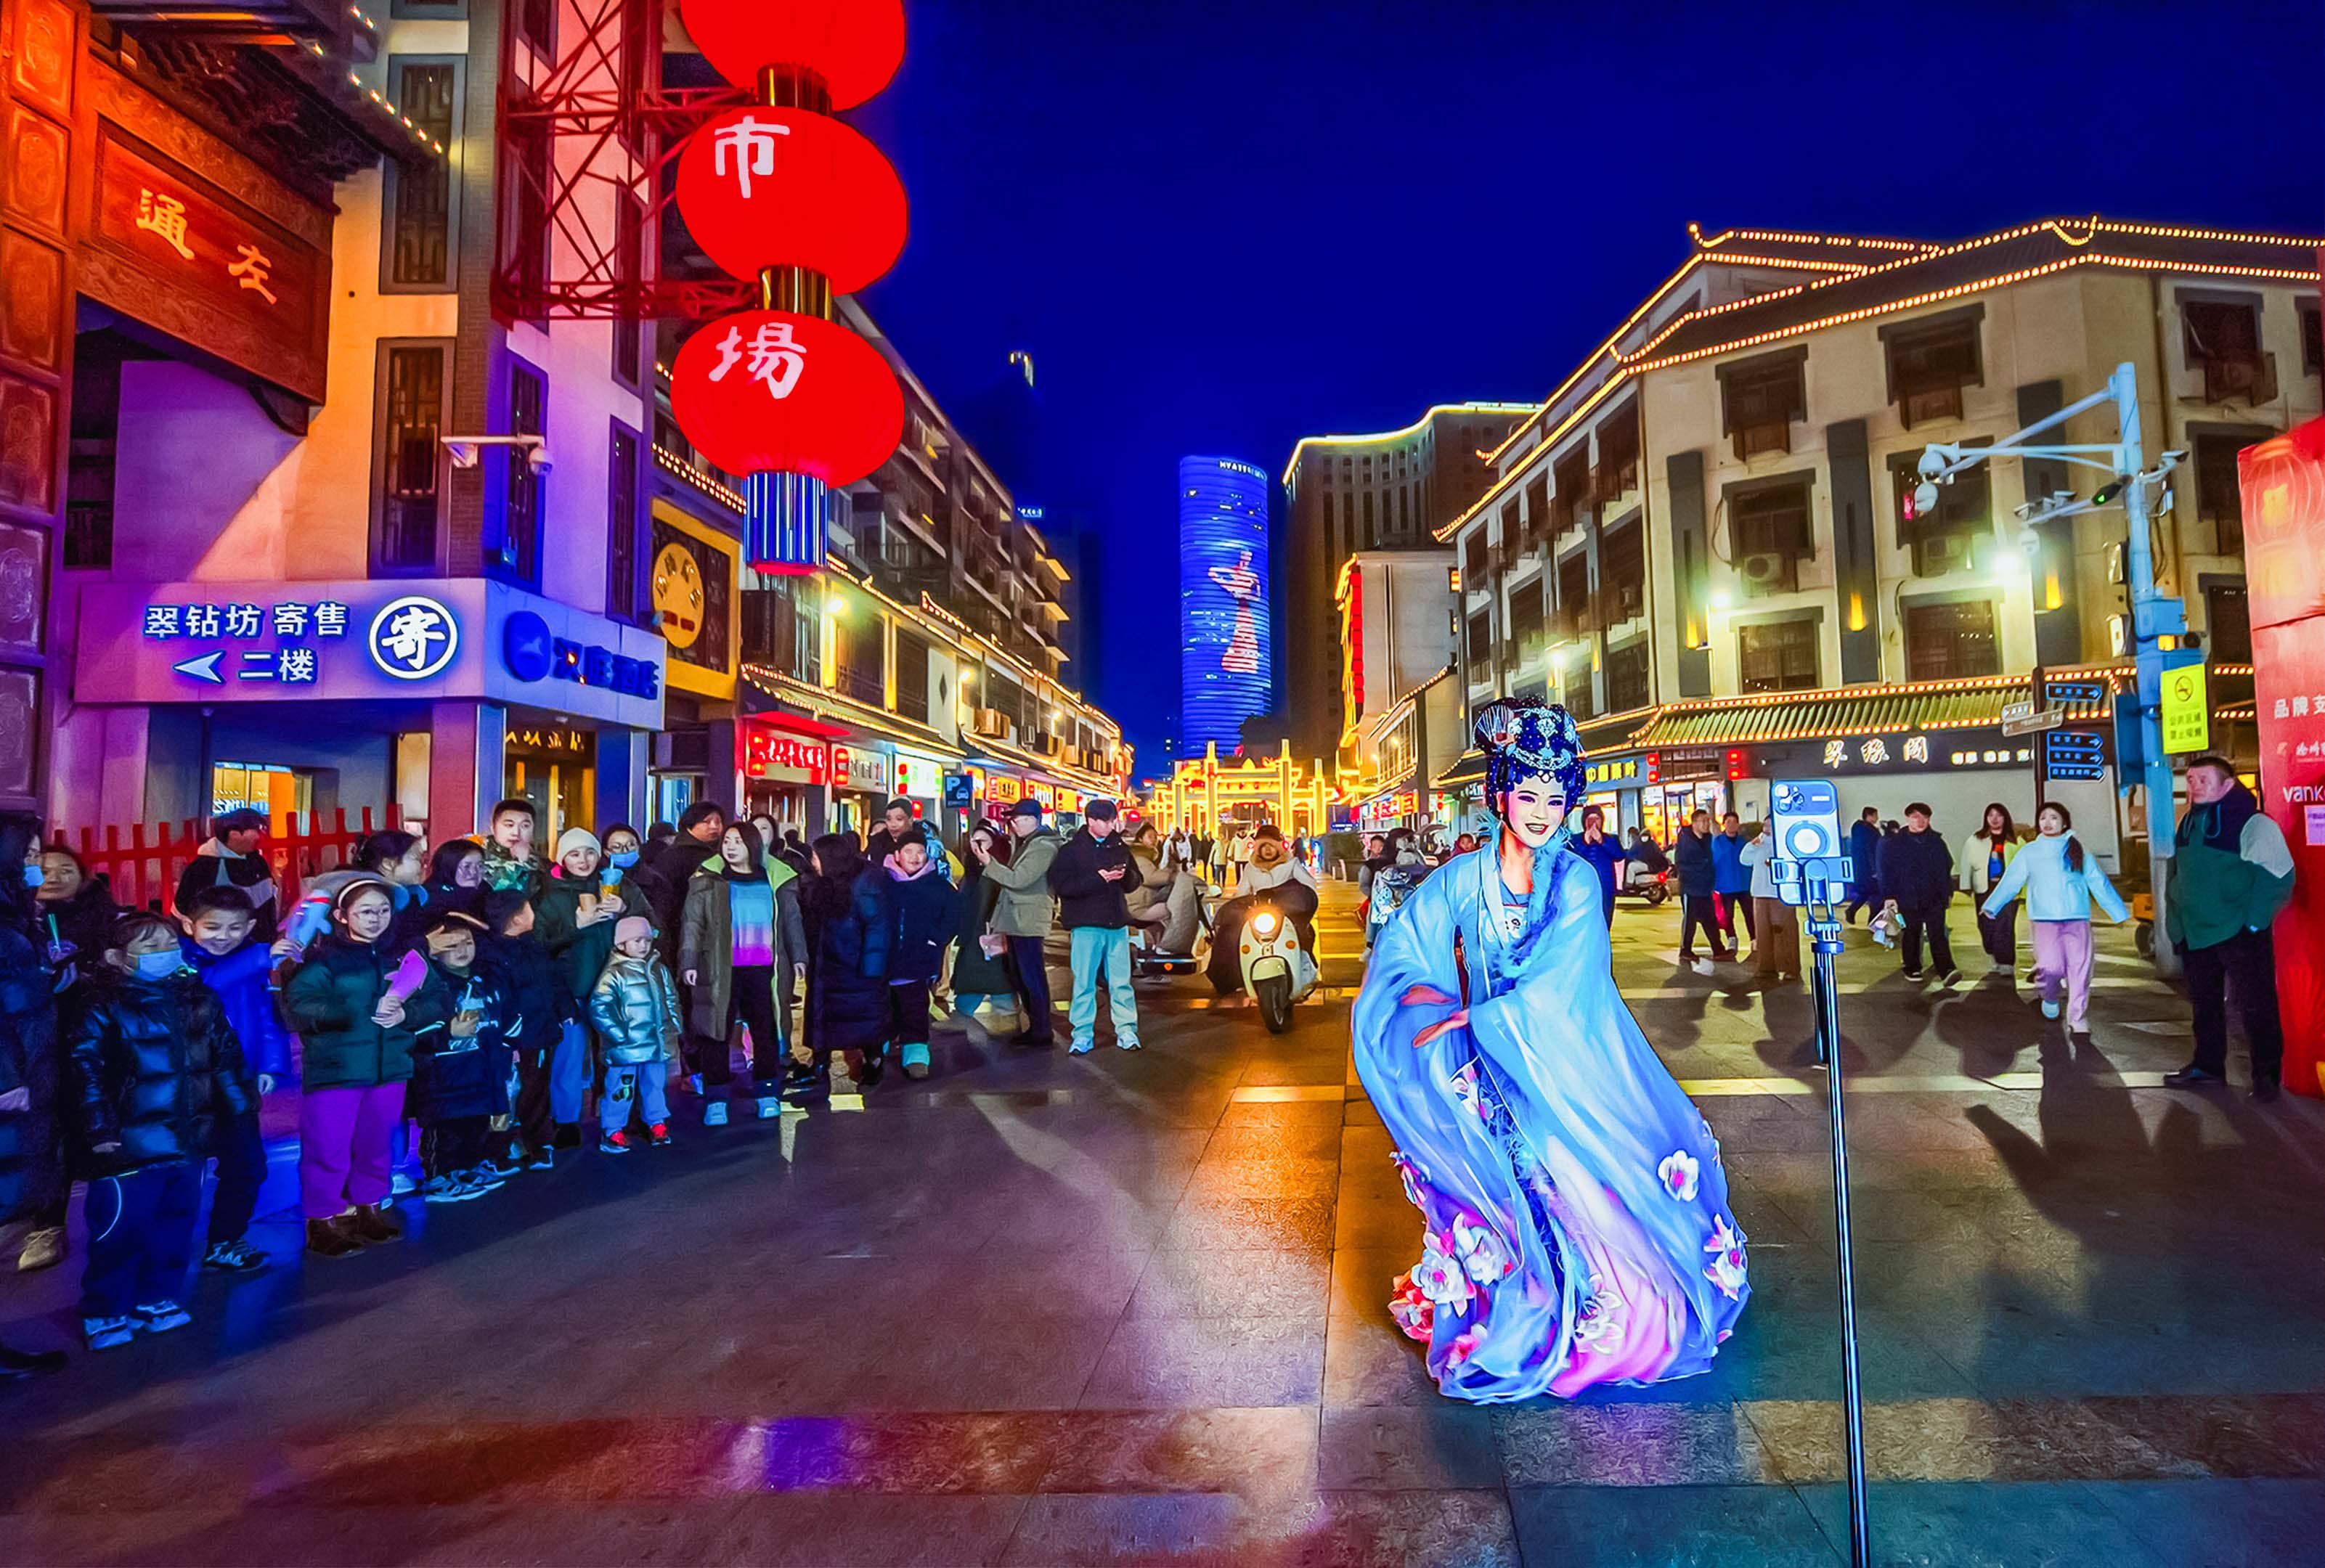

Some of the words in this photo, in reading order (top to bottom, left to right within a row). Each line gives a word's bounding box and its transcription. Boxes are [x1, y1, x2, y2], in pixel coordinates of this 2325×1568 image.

[714, 115, 790, 198] 市
[145, 605, 261, 639] 翠钻坊
[272, 603, 348, 637] 寄售
[380, 606, 447, 671] 寄
[239, 649, 314, 682] 二楼
[946, 777, 961, 791] P
[2283, 785, 2325, 803] vank
